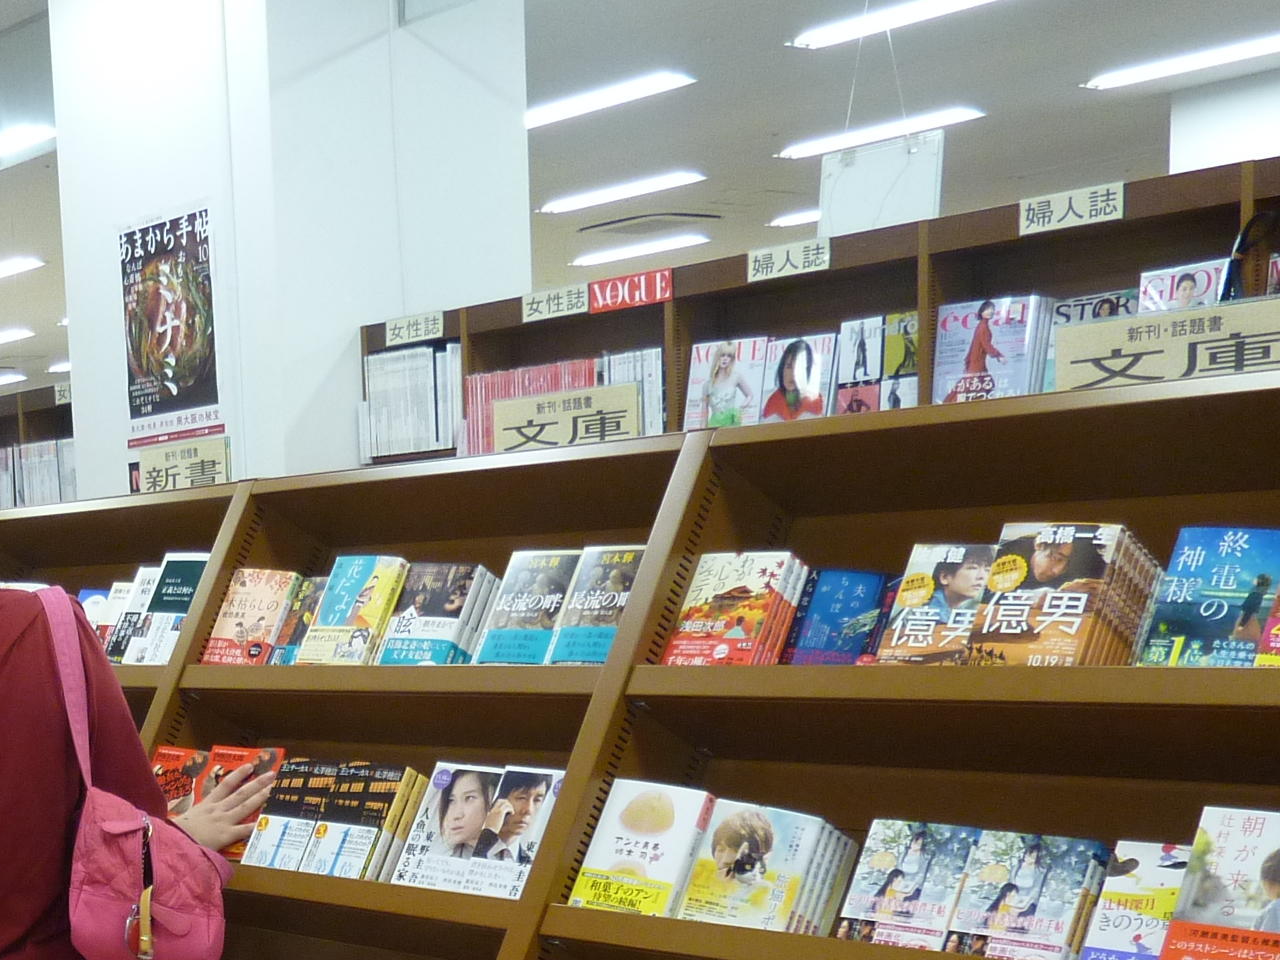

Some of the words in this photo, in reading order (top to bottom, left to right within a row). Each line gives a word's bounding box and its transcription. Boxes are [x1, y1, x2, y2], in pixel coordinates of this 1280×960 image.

[1025, 190, 1118, 228] 婦人誌
[119, 210, 209, 263] あまから手帖
[198, 244, 209, 262] 10
[752, 244, 826, 277] 婦人誌
[526, 288, 586, 317] 女性誌
[593, 270, 671, 308] VOGUE
[389, 316, 441, 342] 女性誌
[1127, 315, 1224, 343] 新刊・話題書
[1069, 332, 1280, 391] 文庫
[536, 396, 593, 415] 新刊・話題書
[502, 409, 631, 451] 文庫
[145, 459, 222, 492] 新書
[1164, 545, 1206, 604] 神様
[1200, 530, 1251, 621] 終電の
[891, 605, 976, 648] 億男
[983, 591, 1089, 636] 億男
[395, 806, 430, 882] 人魚の眠る家
[408, 831, 436, 884] 東野圭吾
[508, 841, 538, 897] 東野圭吾
[1221, 815, 1267, 917] 朝が来る
[1102, 897, 1156, 912] 辻村深月
